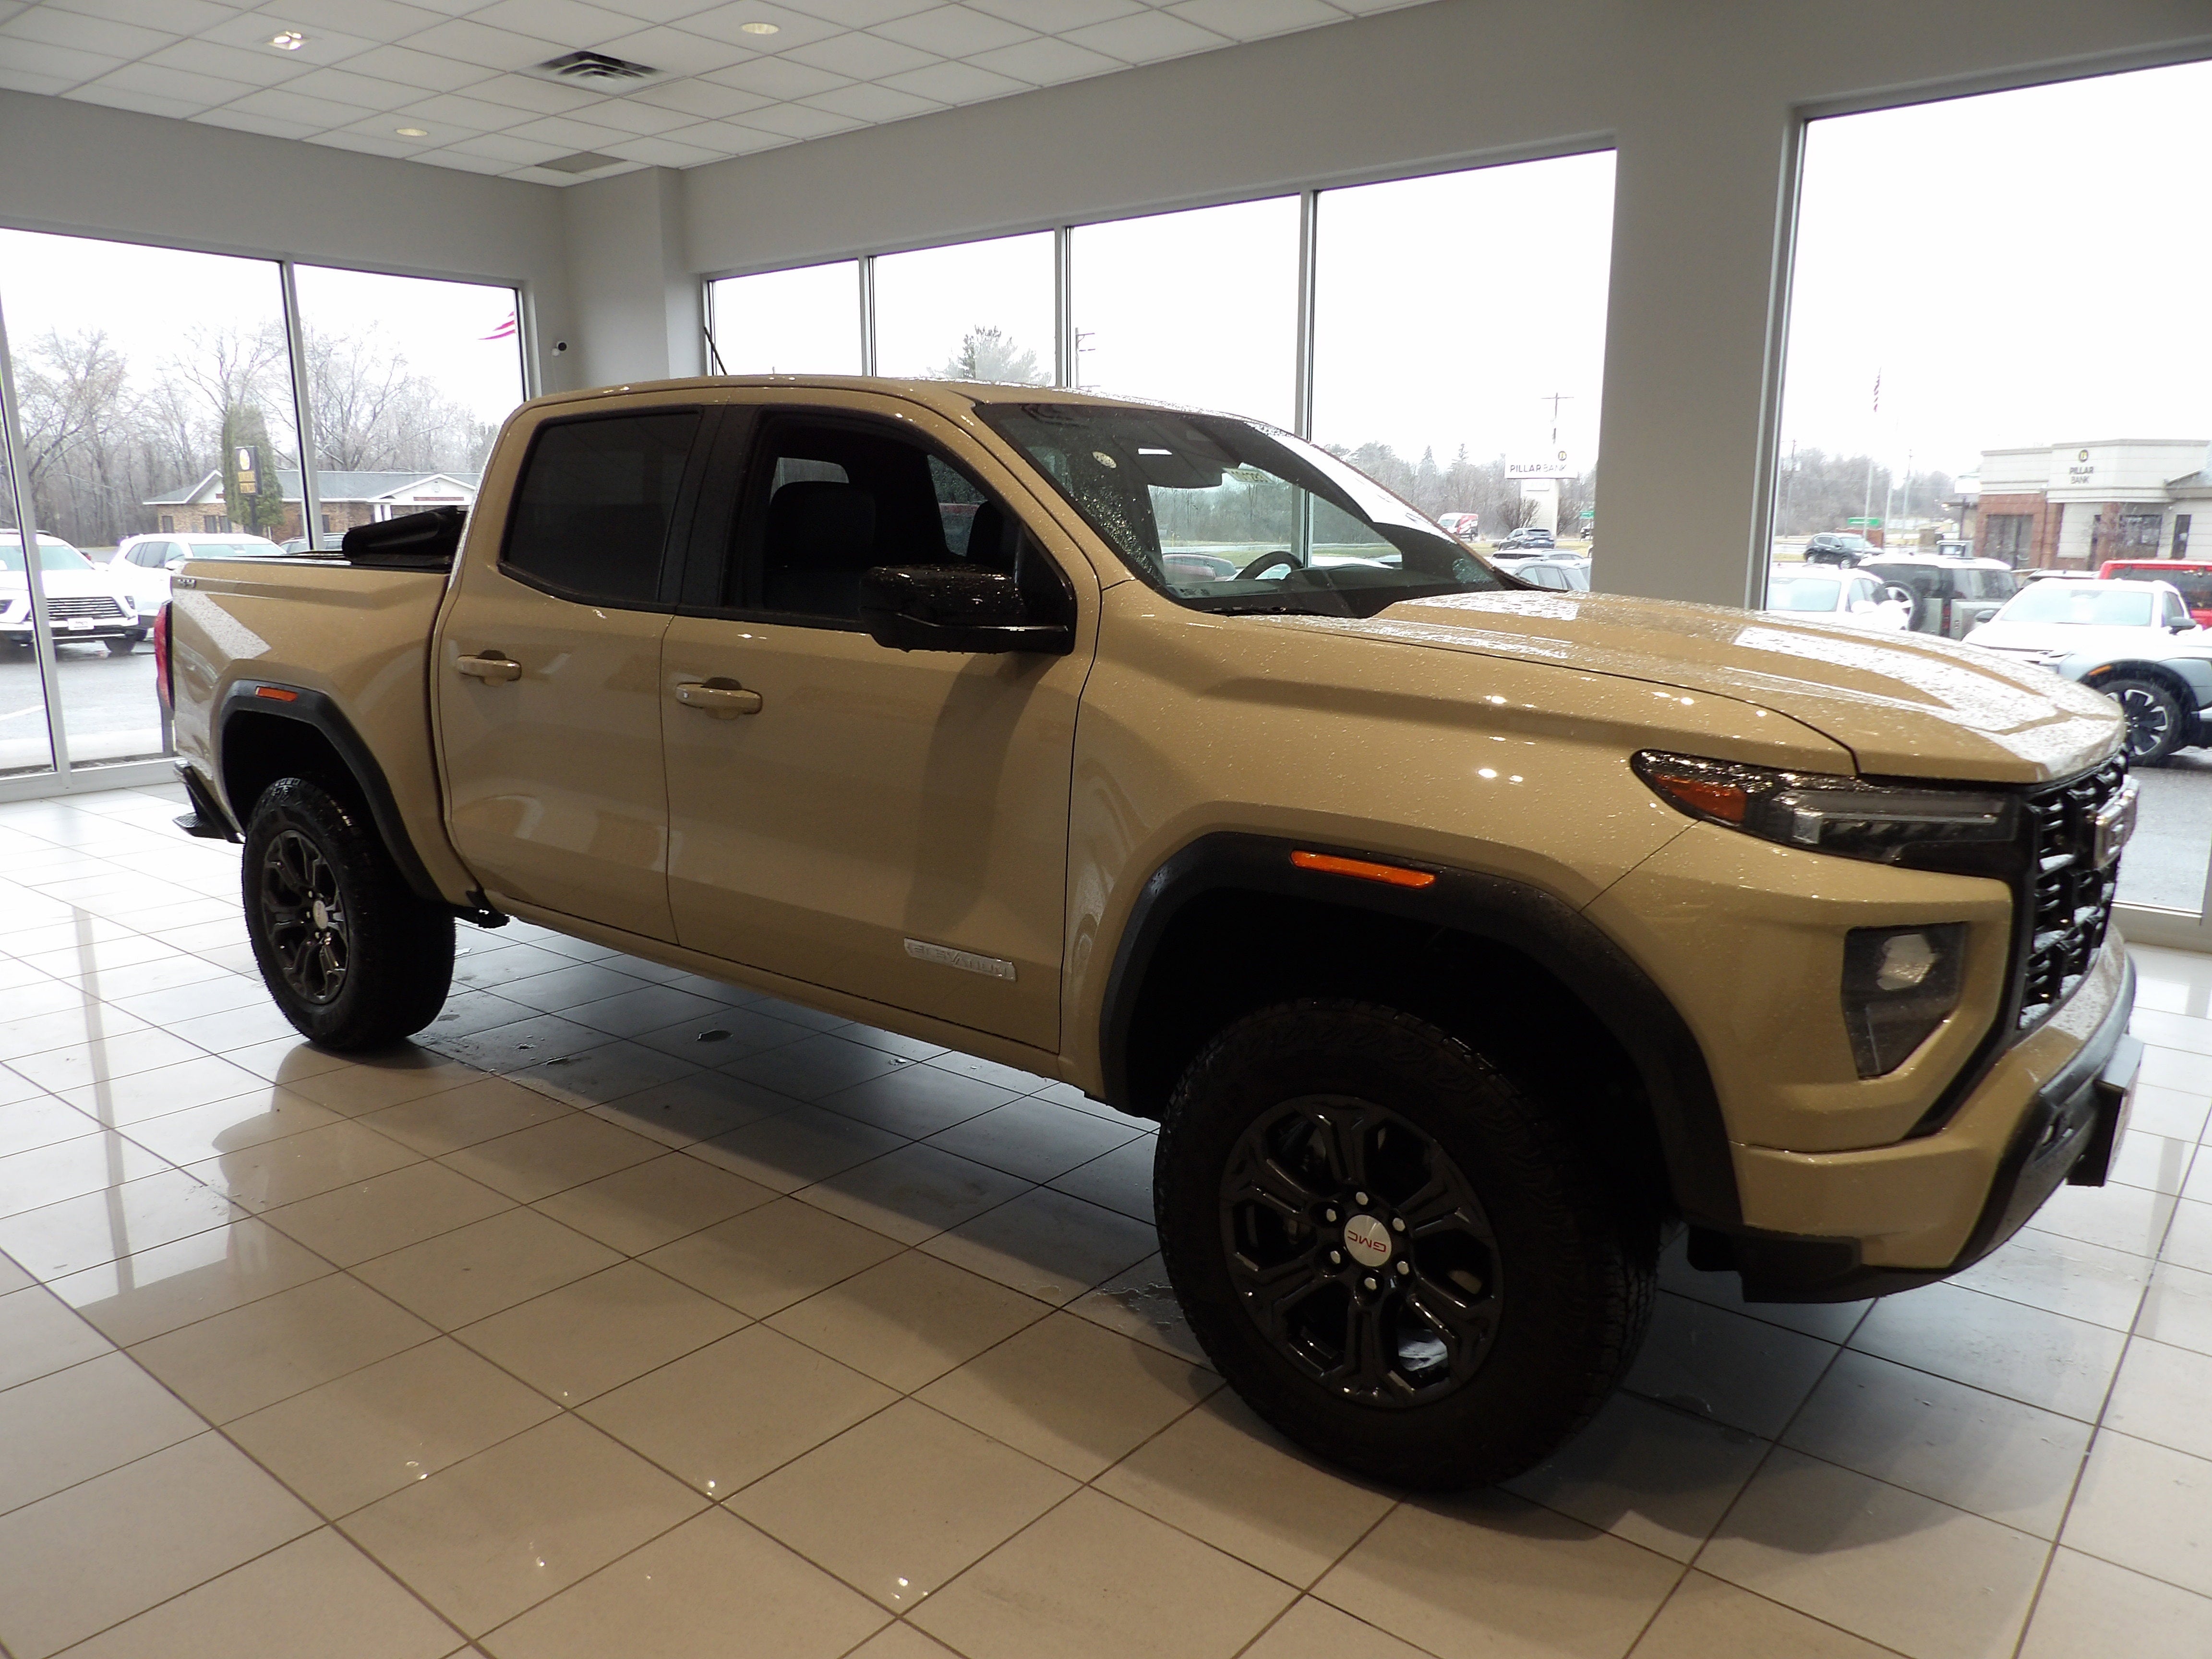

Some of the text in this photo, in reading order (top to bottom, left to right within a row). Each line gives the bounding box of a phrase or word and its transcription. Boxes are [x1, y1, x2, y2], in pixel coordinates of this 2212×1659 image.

[1510, 464, 1567, 473] PILLAR BANK
[2069, 466, 2094, 474] PILLAR
[2070, 475, 2090, 484] BANK
[1347, 1230, 1387, 1253] GMC
